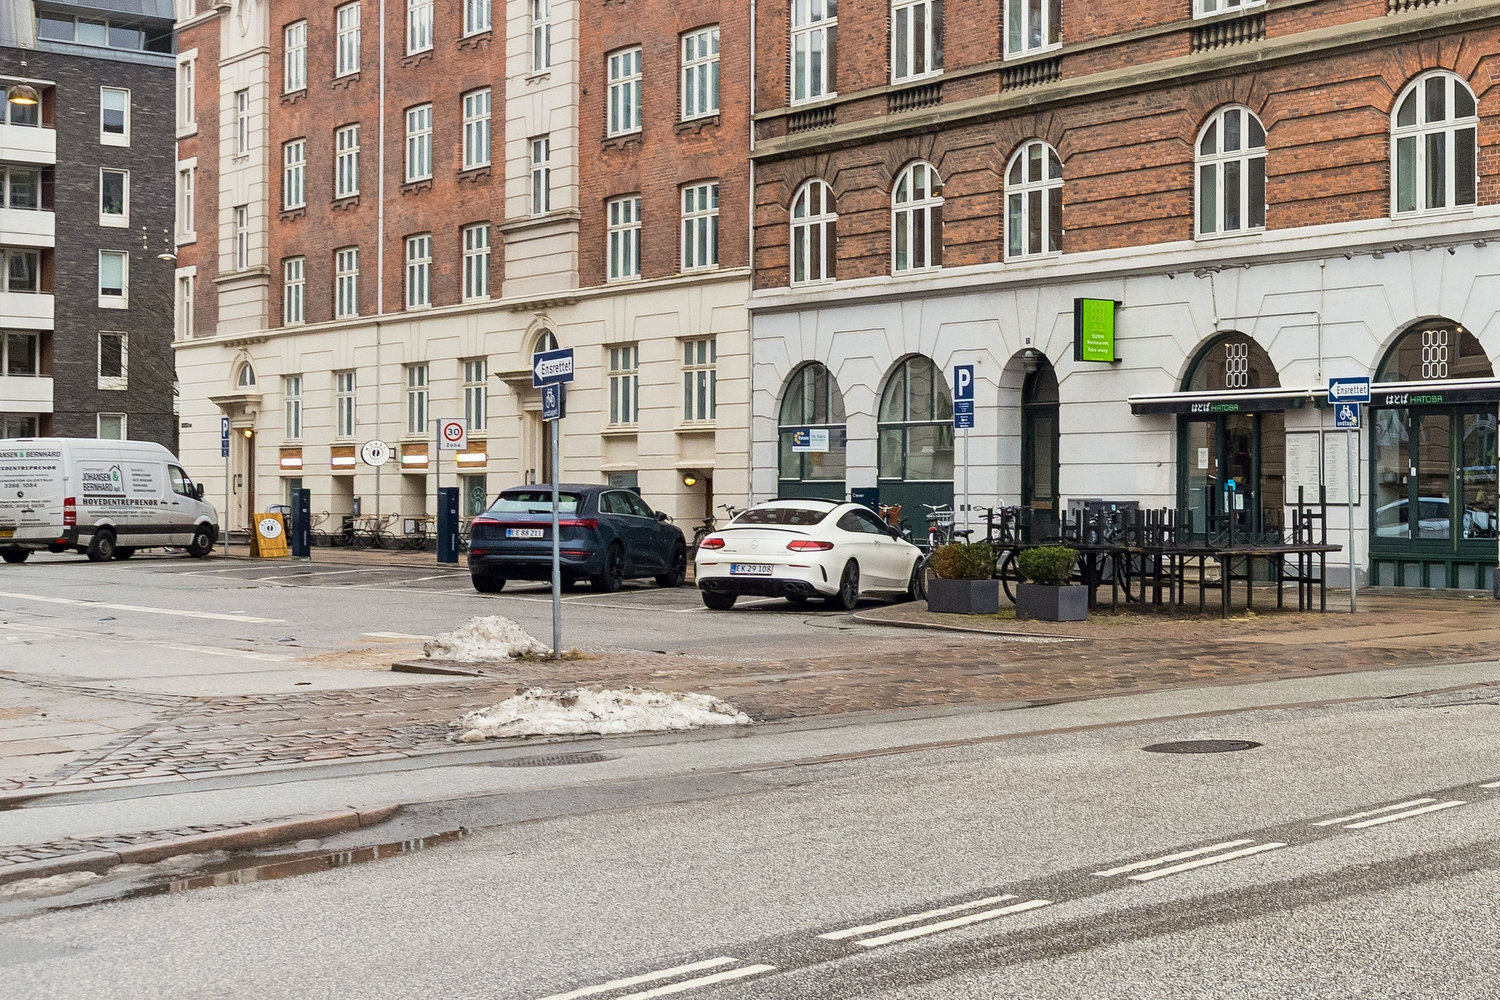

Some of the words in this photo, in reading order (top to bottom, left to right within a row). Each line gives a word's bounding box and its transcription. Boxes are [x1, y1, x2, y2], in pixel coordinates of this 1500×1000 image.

[542, 361, 571, 375] Ensrettet
[959, 369, 971, 396] P
[1336, 386, 1367, 395] Ensrettet
[222, 420, 229, 437] P
[447, 428, 460, 436] 30
[82, 473, 112, 482] JOHANSEN
[112, 471, 119, 481] &
[83, 483, 113, 492] BERNHARD
[82, 498, 158, 506] HOVEDENTREPRENØR
[736, 563, 747, 572] EK
[747, 564, 757, 572] 29
